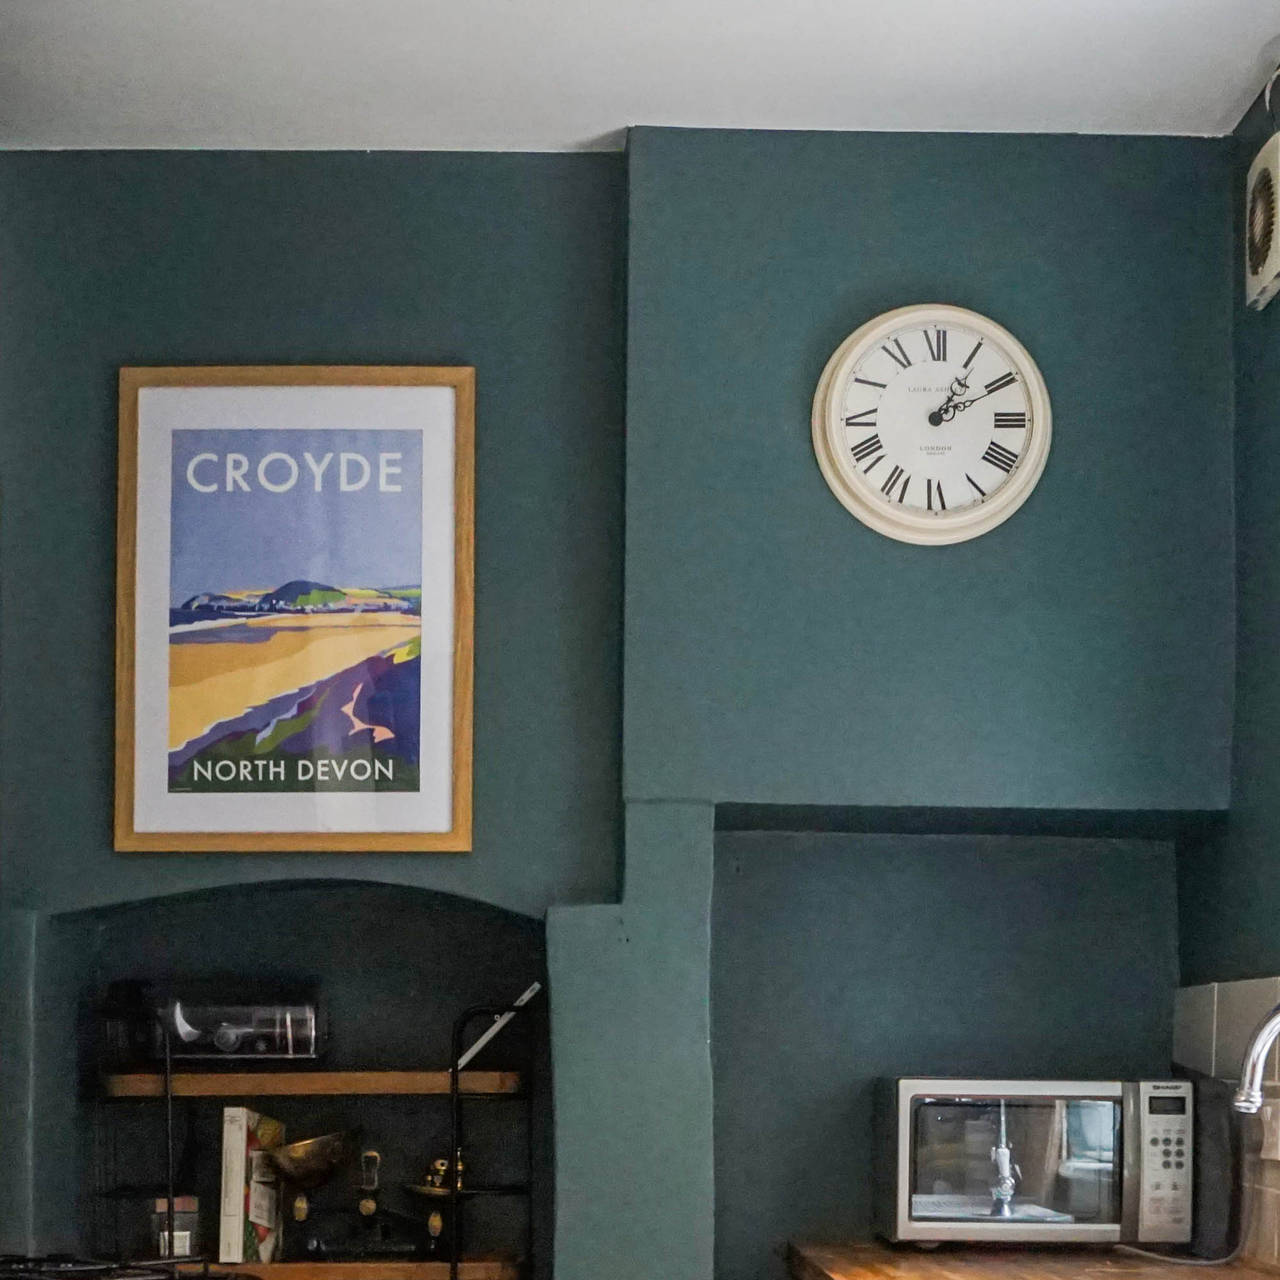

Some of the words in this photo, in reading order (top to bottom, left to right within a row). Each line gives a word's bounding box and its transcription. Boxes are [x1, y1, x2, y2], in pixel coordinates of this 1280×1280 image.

[185, 451, 404, 494] CROYDE
[192, 759, 287, 782] NORTH
[297, 758, 395, 782] DEVON
